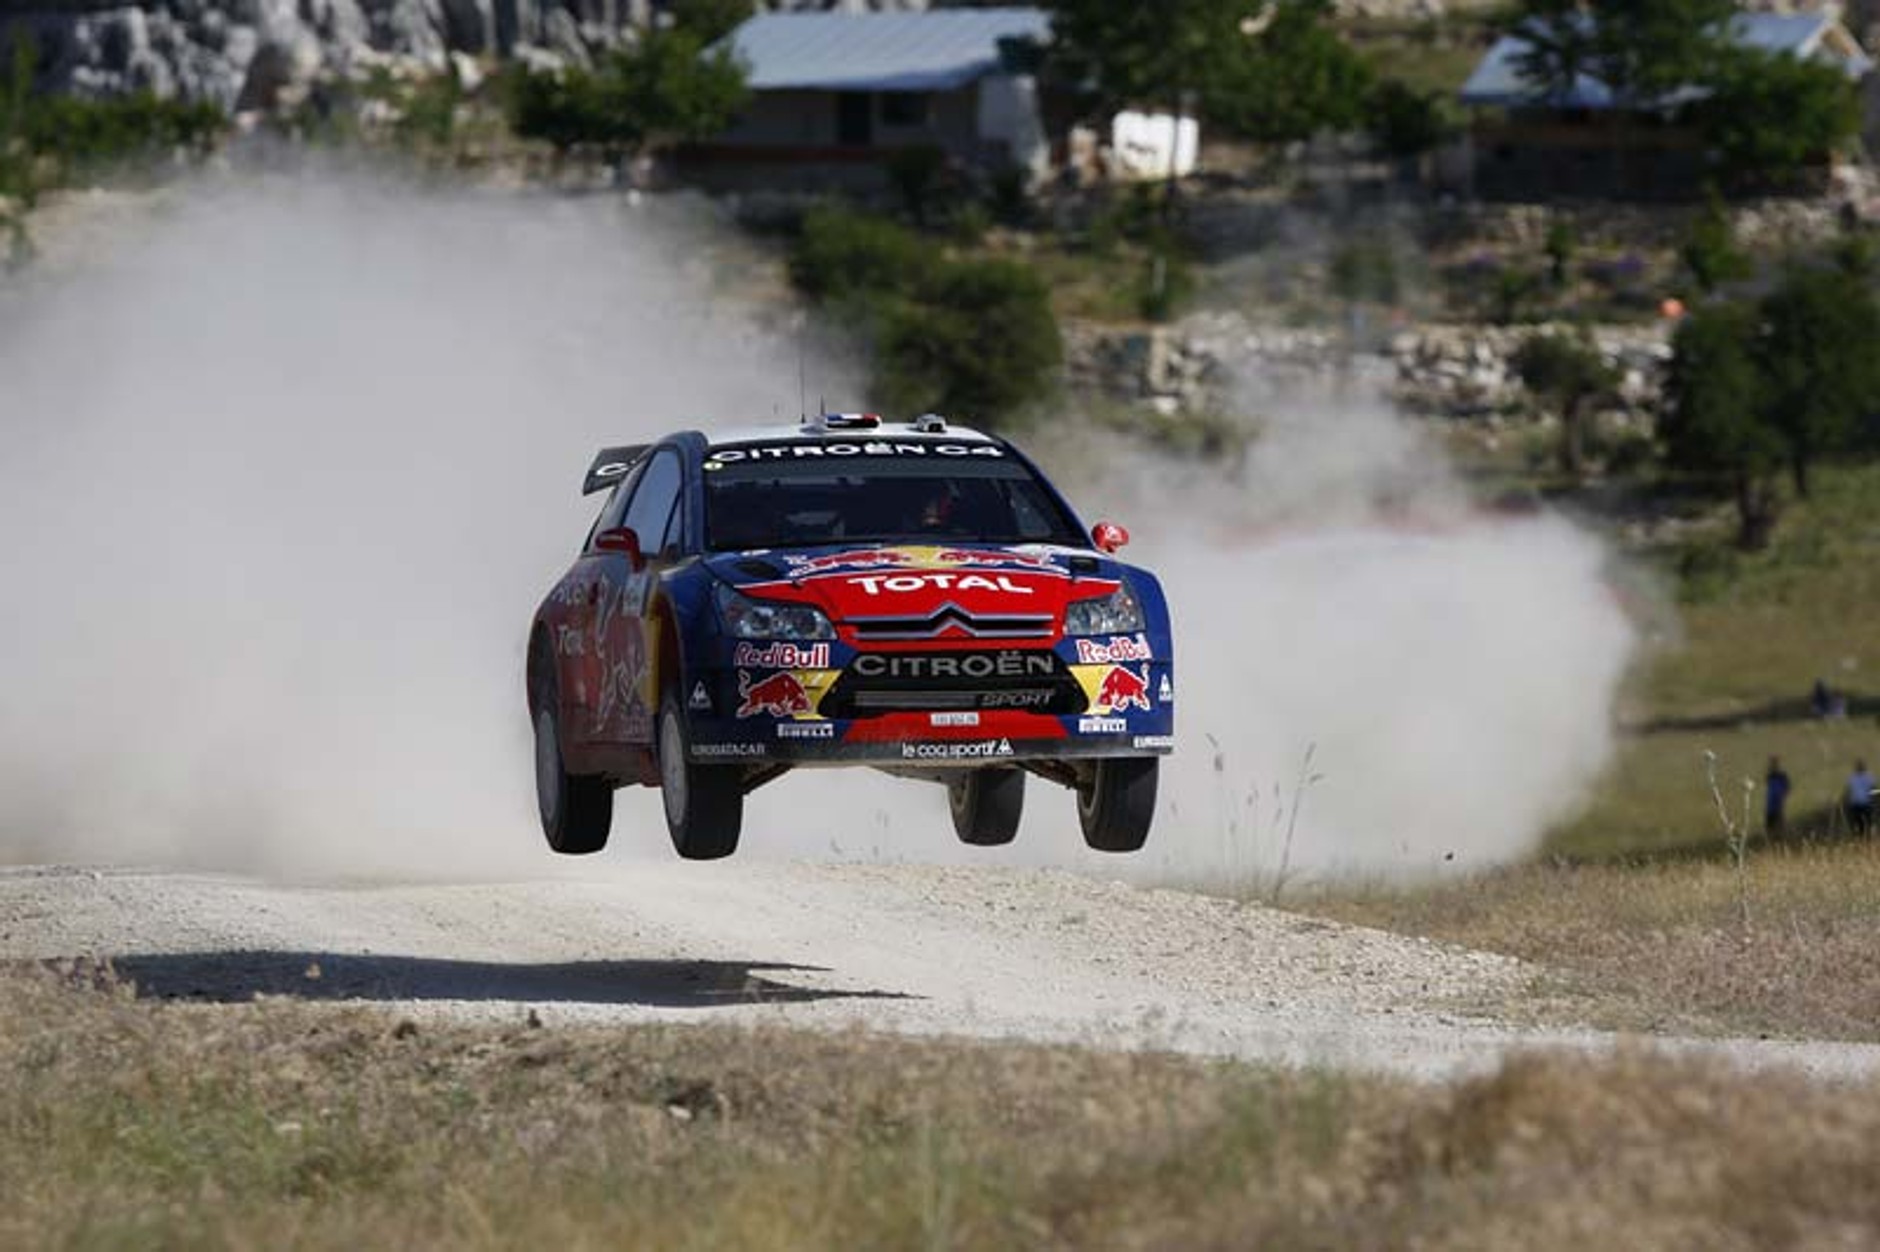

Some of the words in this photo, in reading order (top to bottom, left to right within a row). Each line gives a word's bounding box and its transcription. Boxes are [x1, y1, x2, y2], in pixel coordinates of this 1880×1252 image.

[711, 442, 926, 461] CITROËN
[935, 444, 1004, 458] C4
[846, 575, 1035, 596] TOTAL
[853, 650, 1055, 677] CITROËN
[902, 742, 915, 758] le
[917, 745, 948, 758] coq
